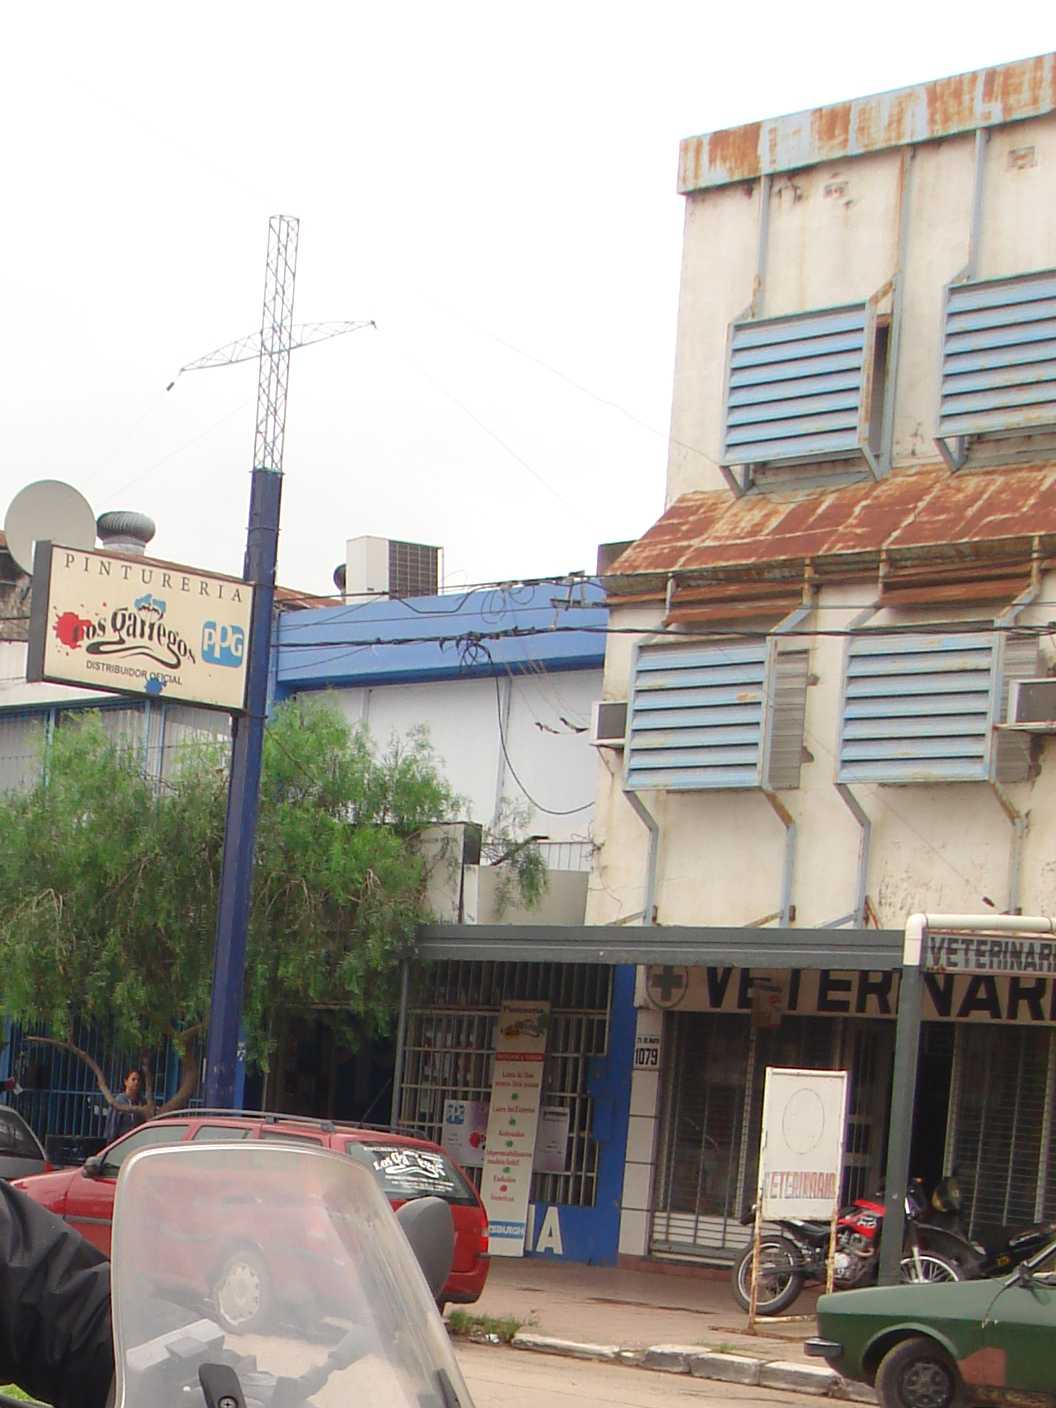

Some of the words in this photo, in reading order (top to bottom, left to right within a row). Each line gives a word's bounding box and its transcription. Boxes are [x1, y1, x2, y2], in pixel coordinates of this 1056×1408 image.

[65, 554, 242, 603] PINTURERIA
[203, 623, 243, 659] PPG
[86, 660, 147, 679] DISTRIBUIDOR
[635, 1048, 658, 1065] 1079
